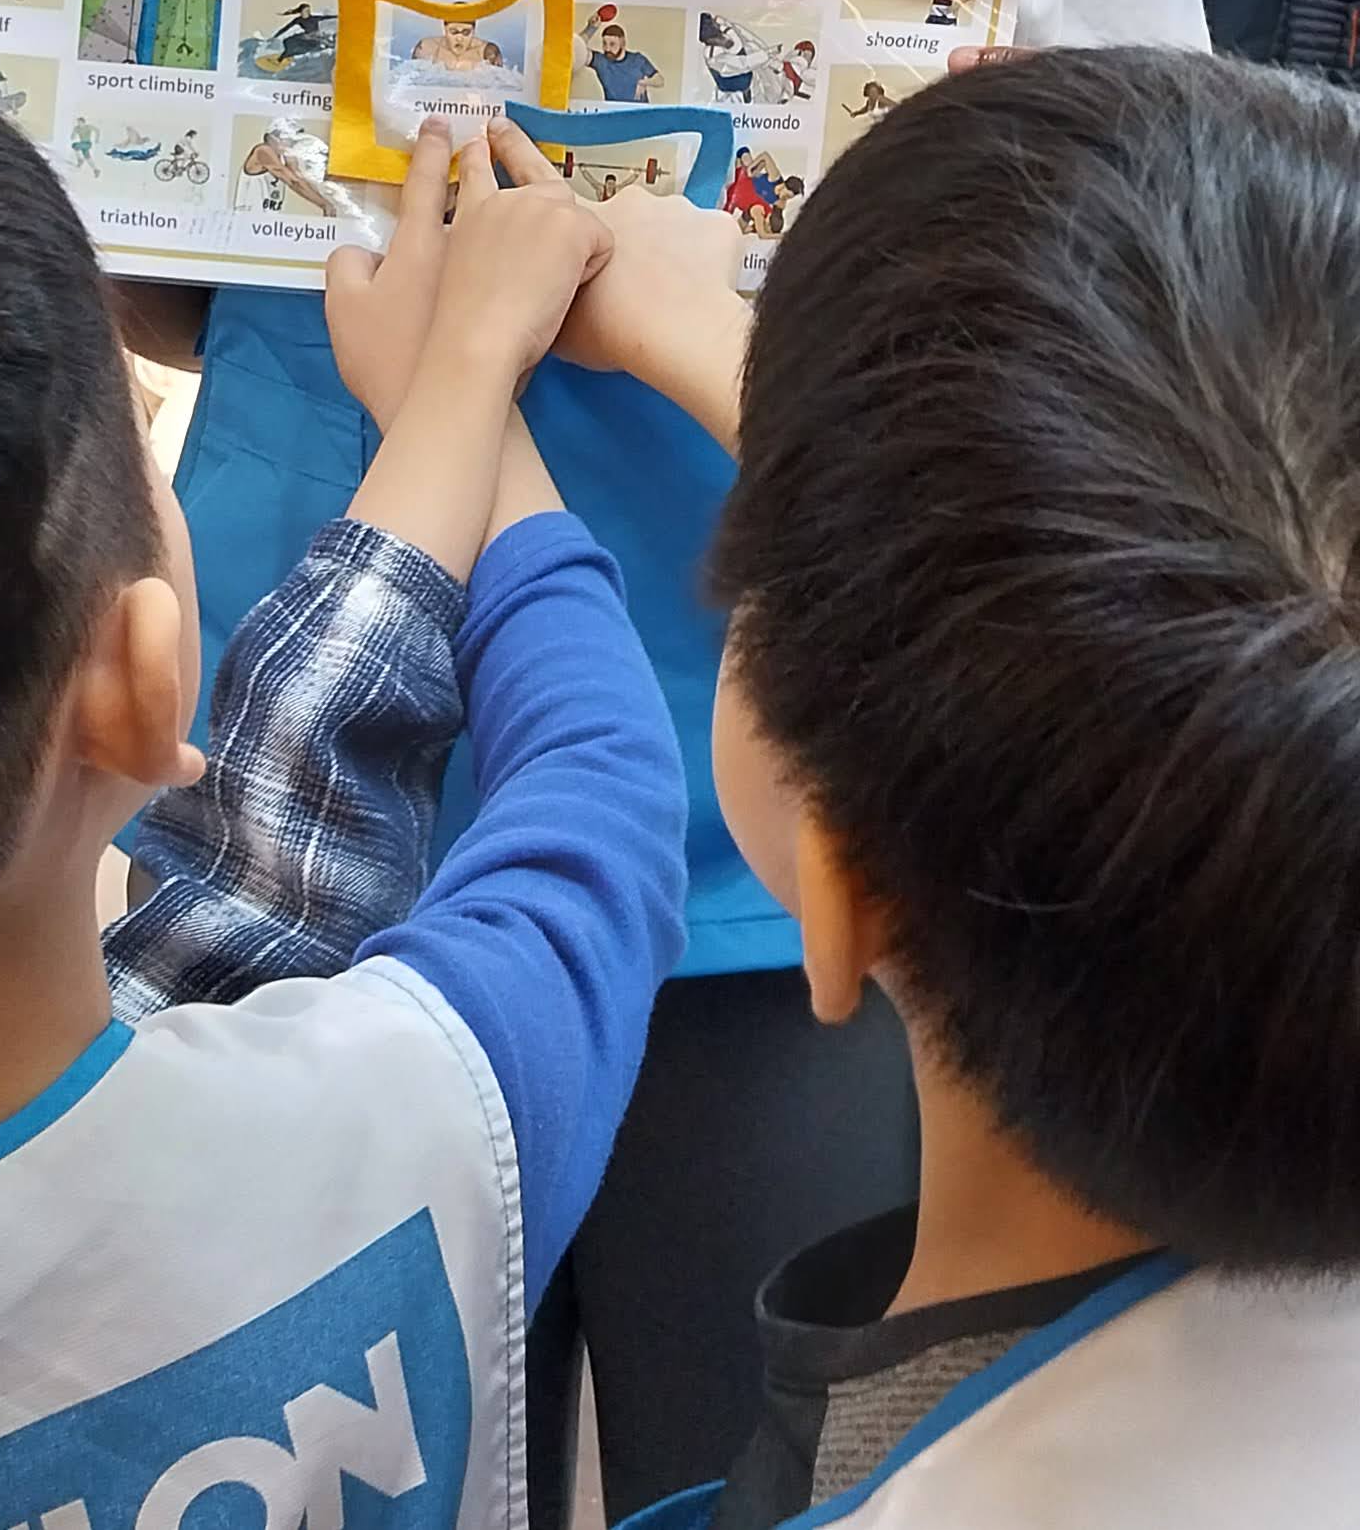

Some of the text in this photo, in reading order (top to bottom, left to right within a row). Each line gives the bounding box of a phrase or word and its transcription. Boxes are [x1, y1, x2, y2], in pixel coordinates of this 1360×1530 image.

[866, 32, 940, 54] shooting
[87, 71, 215, 99] sport climbing
[272, 88, 333, 110] surfing
[101, 208, 178, 230] triathlon
[252, 221, 337, 243] volleyball
